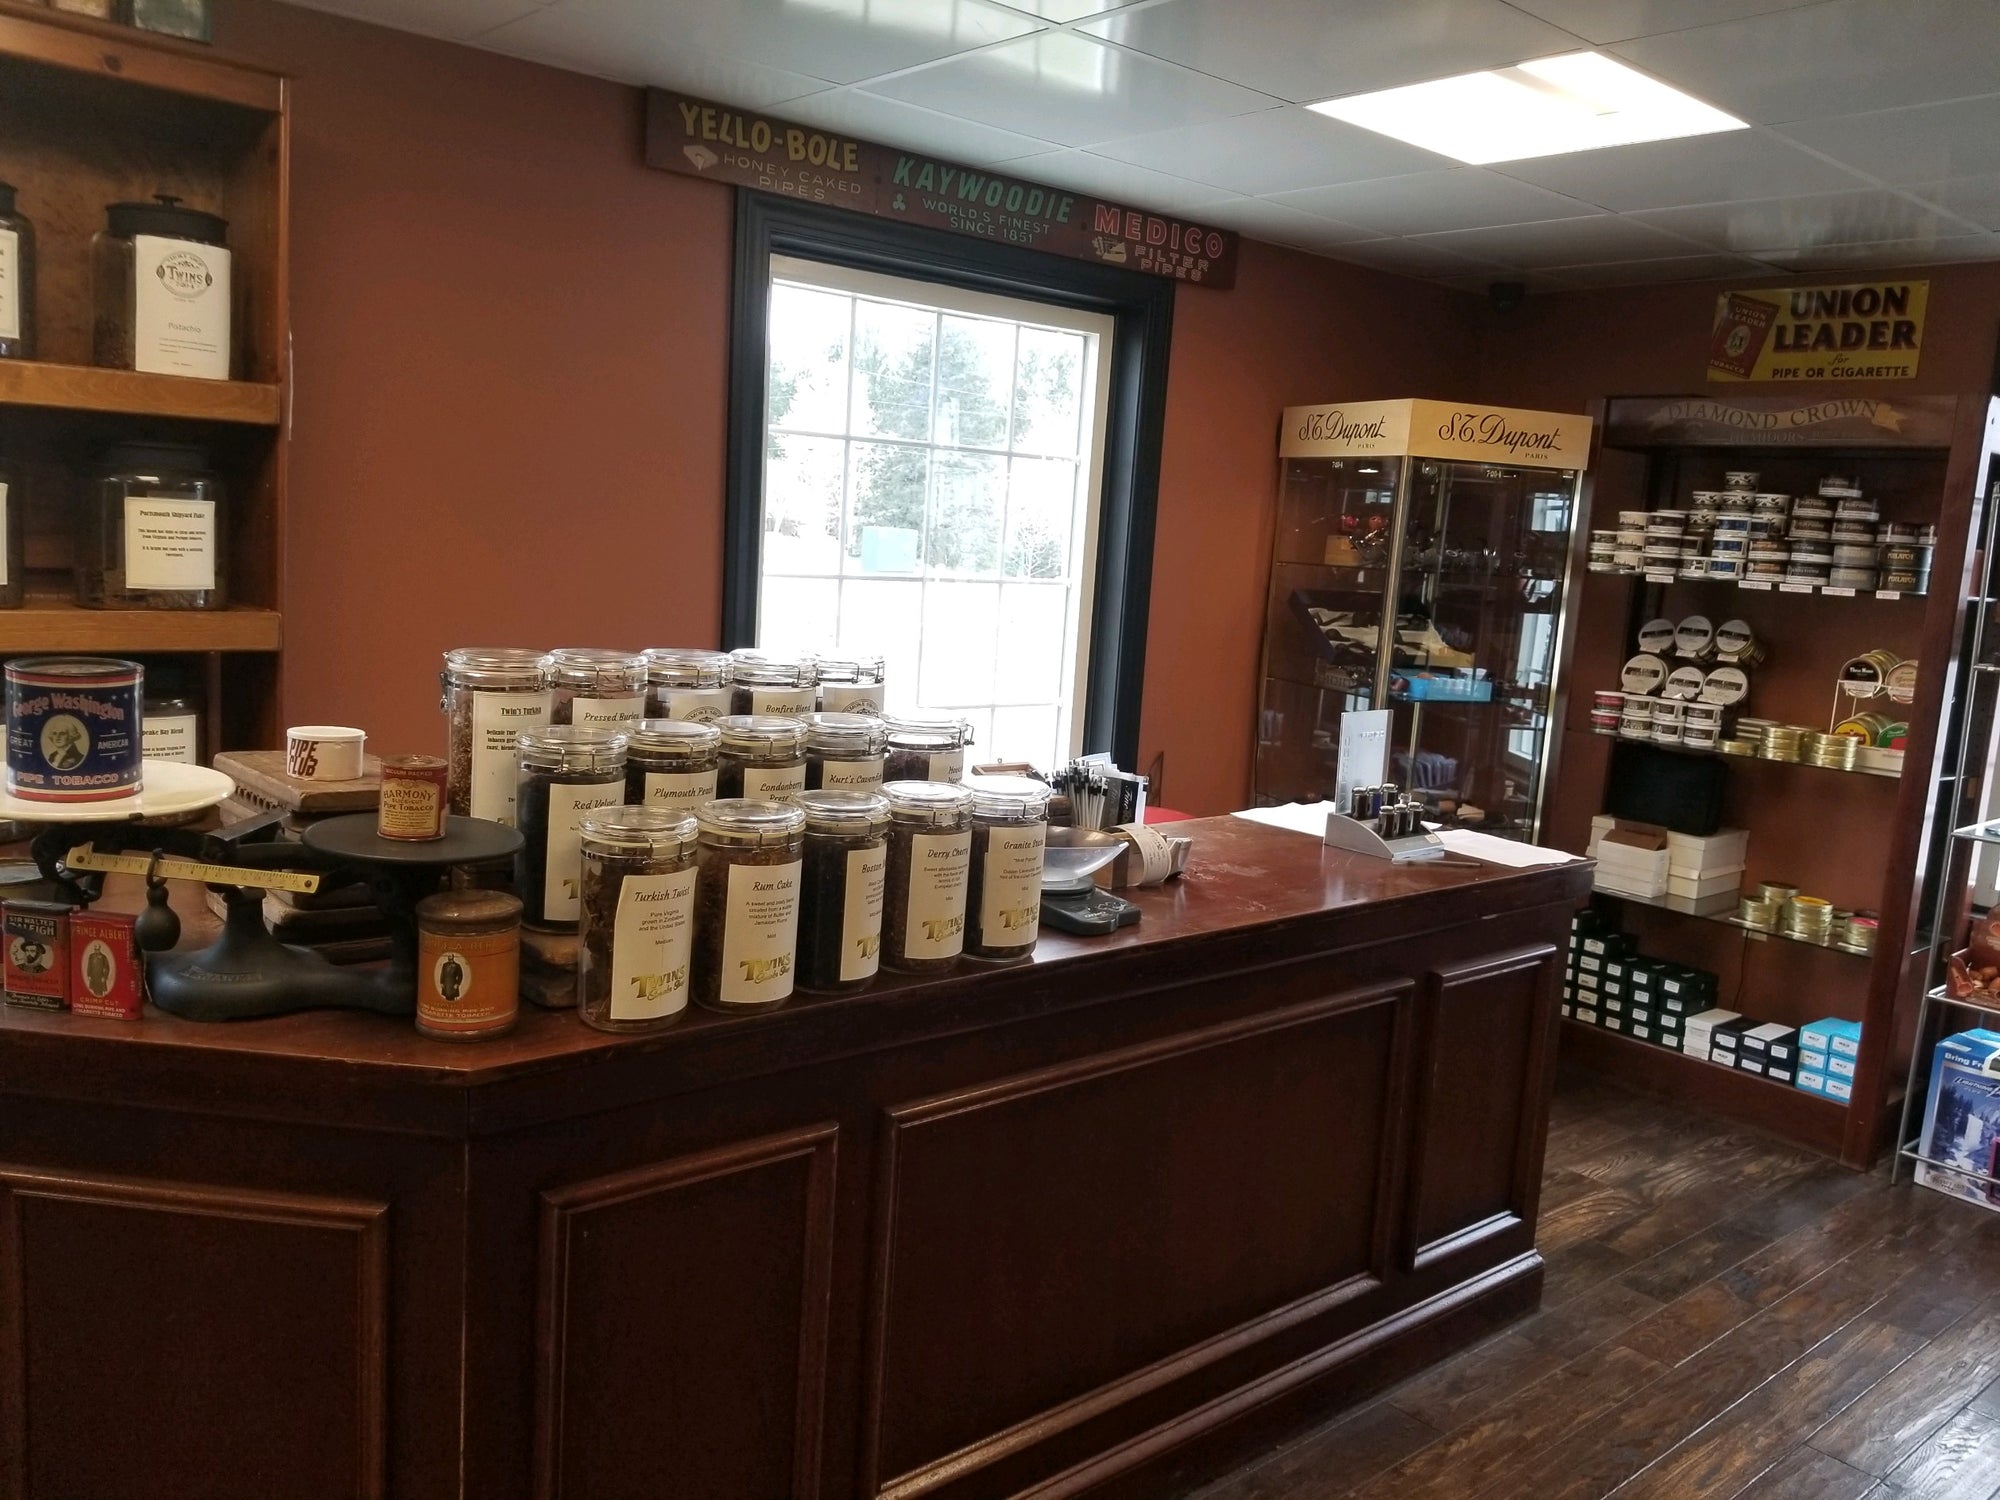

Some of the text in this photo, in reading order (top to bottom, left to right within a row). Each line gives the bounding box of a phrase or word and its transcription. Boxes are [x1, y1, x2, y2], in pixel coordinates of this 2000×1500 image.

[678, 102, 859, 172] YELLO-BOLE
[723, 153, 861, 195] HONEY CAKED
[759, 175, 826, 201] PIPES
[892, 155, 1075, 224] KAYWOODIE
[950, 216, 1033, 244] SINCE 1851
[998, 214, 1051, 235] FINEST
[1094, 203, 1223, 260] MEDICO
[1134, 244, 1208, 272] FILTER
[165, 265, 203, 285] TWINS
[1139, 256, 1200, 283] PIPES
[1790, 285, 1911, 321] UNION
[1772, 319, 1920, 353] LEADER
[1827, 352, 1850, 366] for
[1771, 365, 1910, 380] PIPE OR CIGARETTE
[1666, 400, 1880, 430] DIAMOND CROWN
[1524, 452, 1549, 460] PARIS
[50, 692, 125, 721] Washington
[501, 707, 521, 716] Twin's
[765, 704, 794, 713] Bonfire
[583, 712, 617, 722] Pressed
[10, 735, 129, 751] GREAT AMERICAN
[289, 738, 319, 759] PIPE
[17, 770, 119, 786] PIPE TOBACCO
[828, 774, 854, 784] Kurt's
[383, 789, 436, 802] HARMONY
[653, 787, 696, 800] Plymouth
[572, 799, 591, 810] Red
[1003, 840, 1031, 850] Granite
[927, 848, 950, 860] Derry
[861, 863, 881, 874] Boston
[752, 878, 793, 891] Rum Cake
[634, 889, 671, 902] Turkish
[8, 915, 55, 927] SIR WALTER
[75, 925, 128, 940] PRINCE ALBERT
[739, 951, 791, 982] TWINS
[630, 964, 686, 999] TWINS
[80, 996, 103, 1004] CRIMP
[1944, 1052, 1970, 1067] Bring
